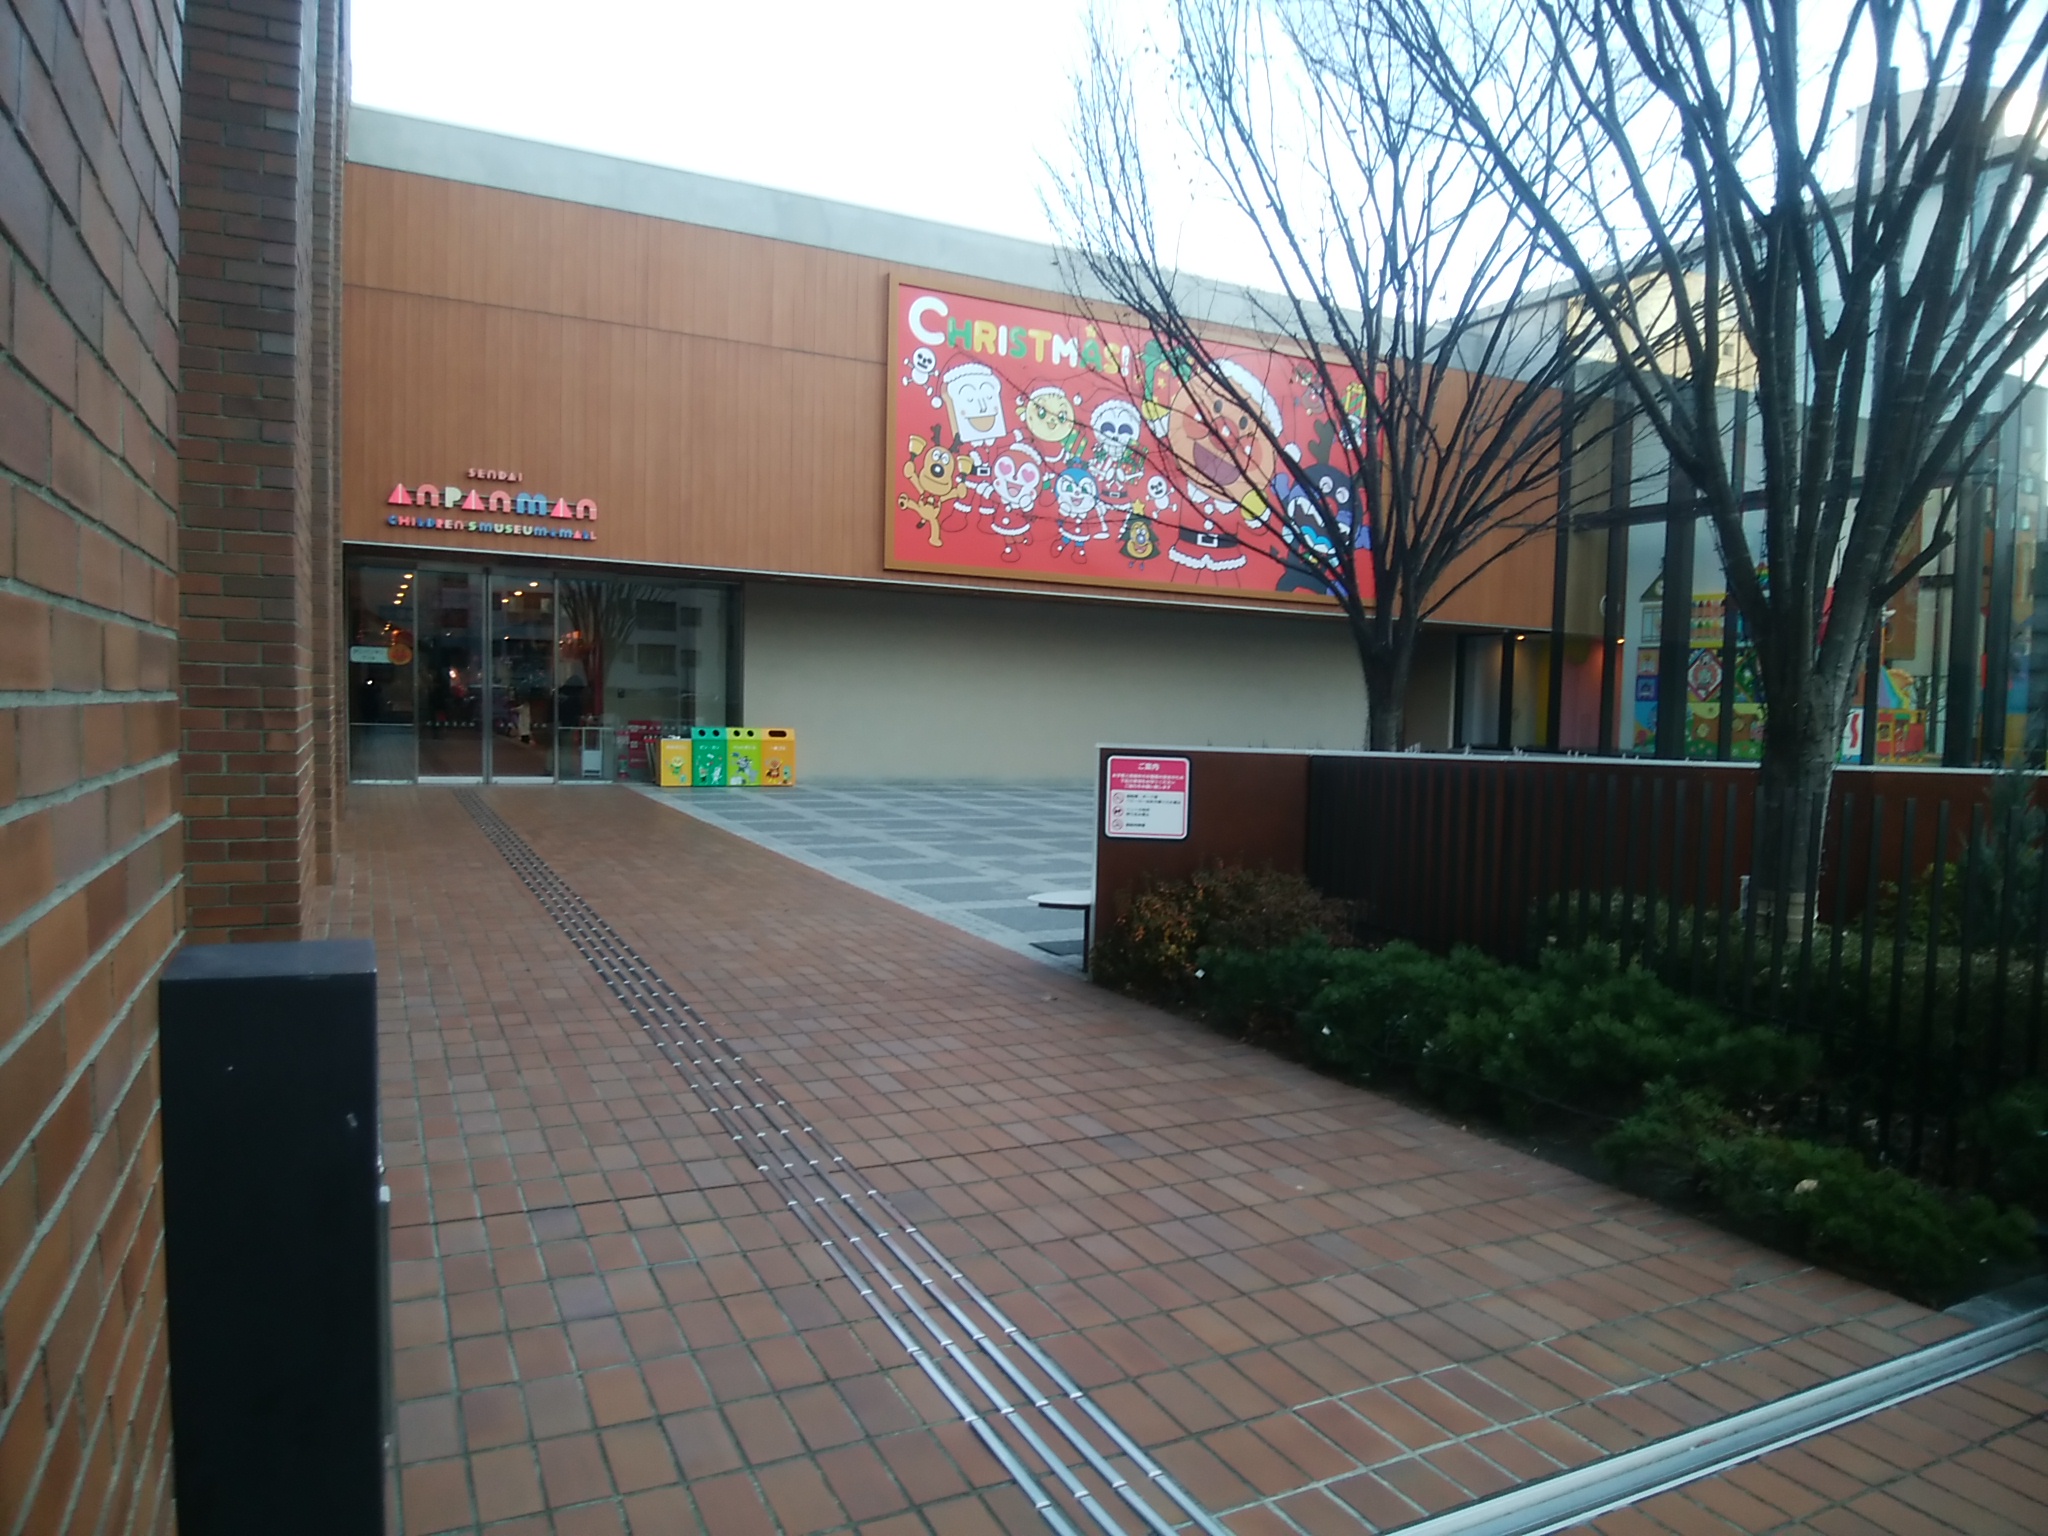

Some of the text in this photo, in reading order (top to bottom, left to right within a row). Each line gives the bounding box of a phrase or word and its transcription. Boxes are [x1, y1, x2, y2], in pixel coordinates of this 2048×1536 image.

[908, 296, 1131, 377] CHRISTMAS!
[467, 468, 523, 482] SENDAI
[387, 483, 598, 520] ANPANMAN
[479, 522, 547, 536] MUSEUM
[558, 528, 598, 540] MALL
